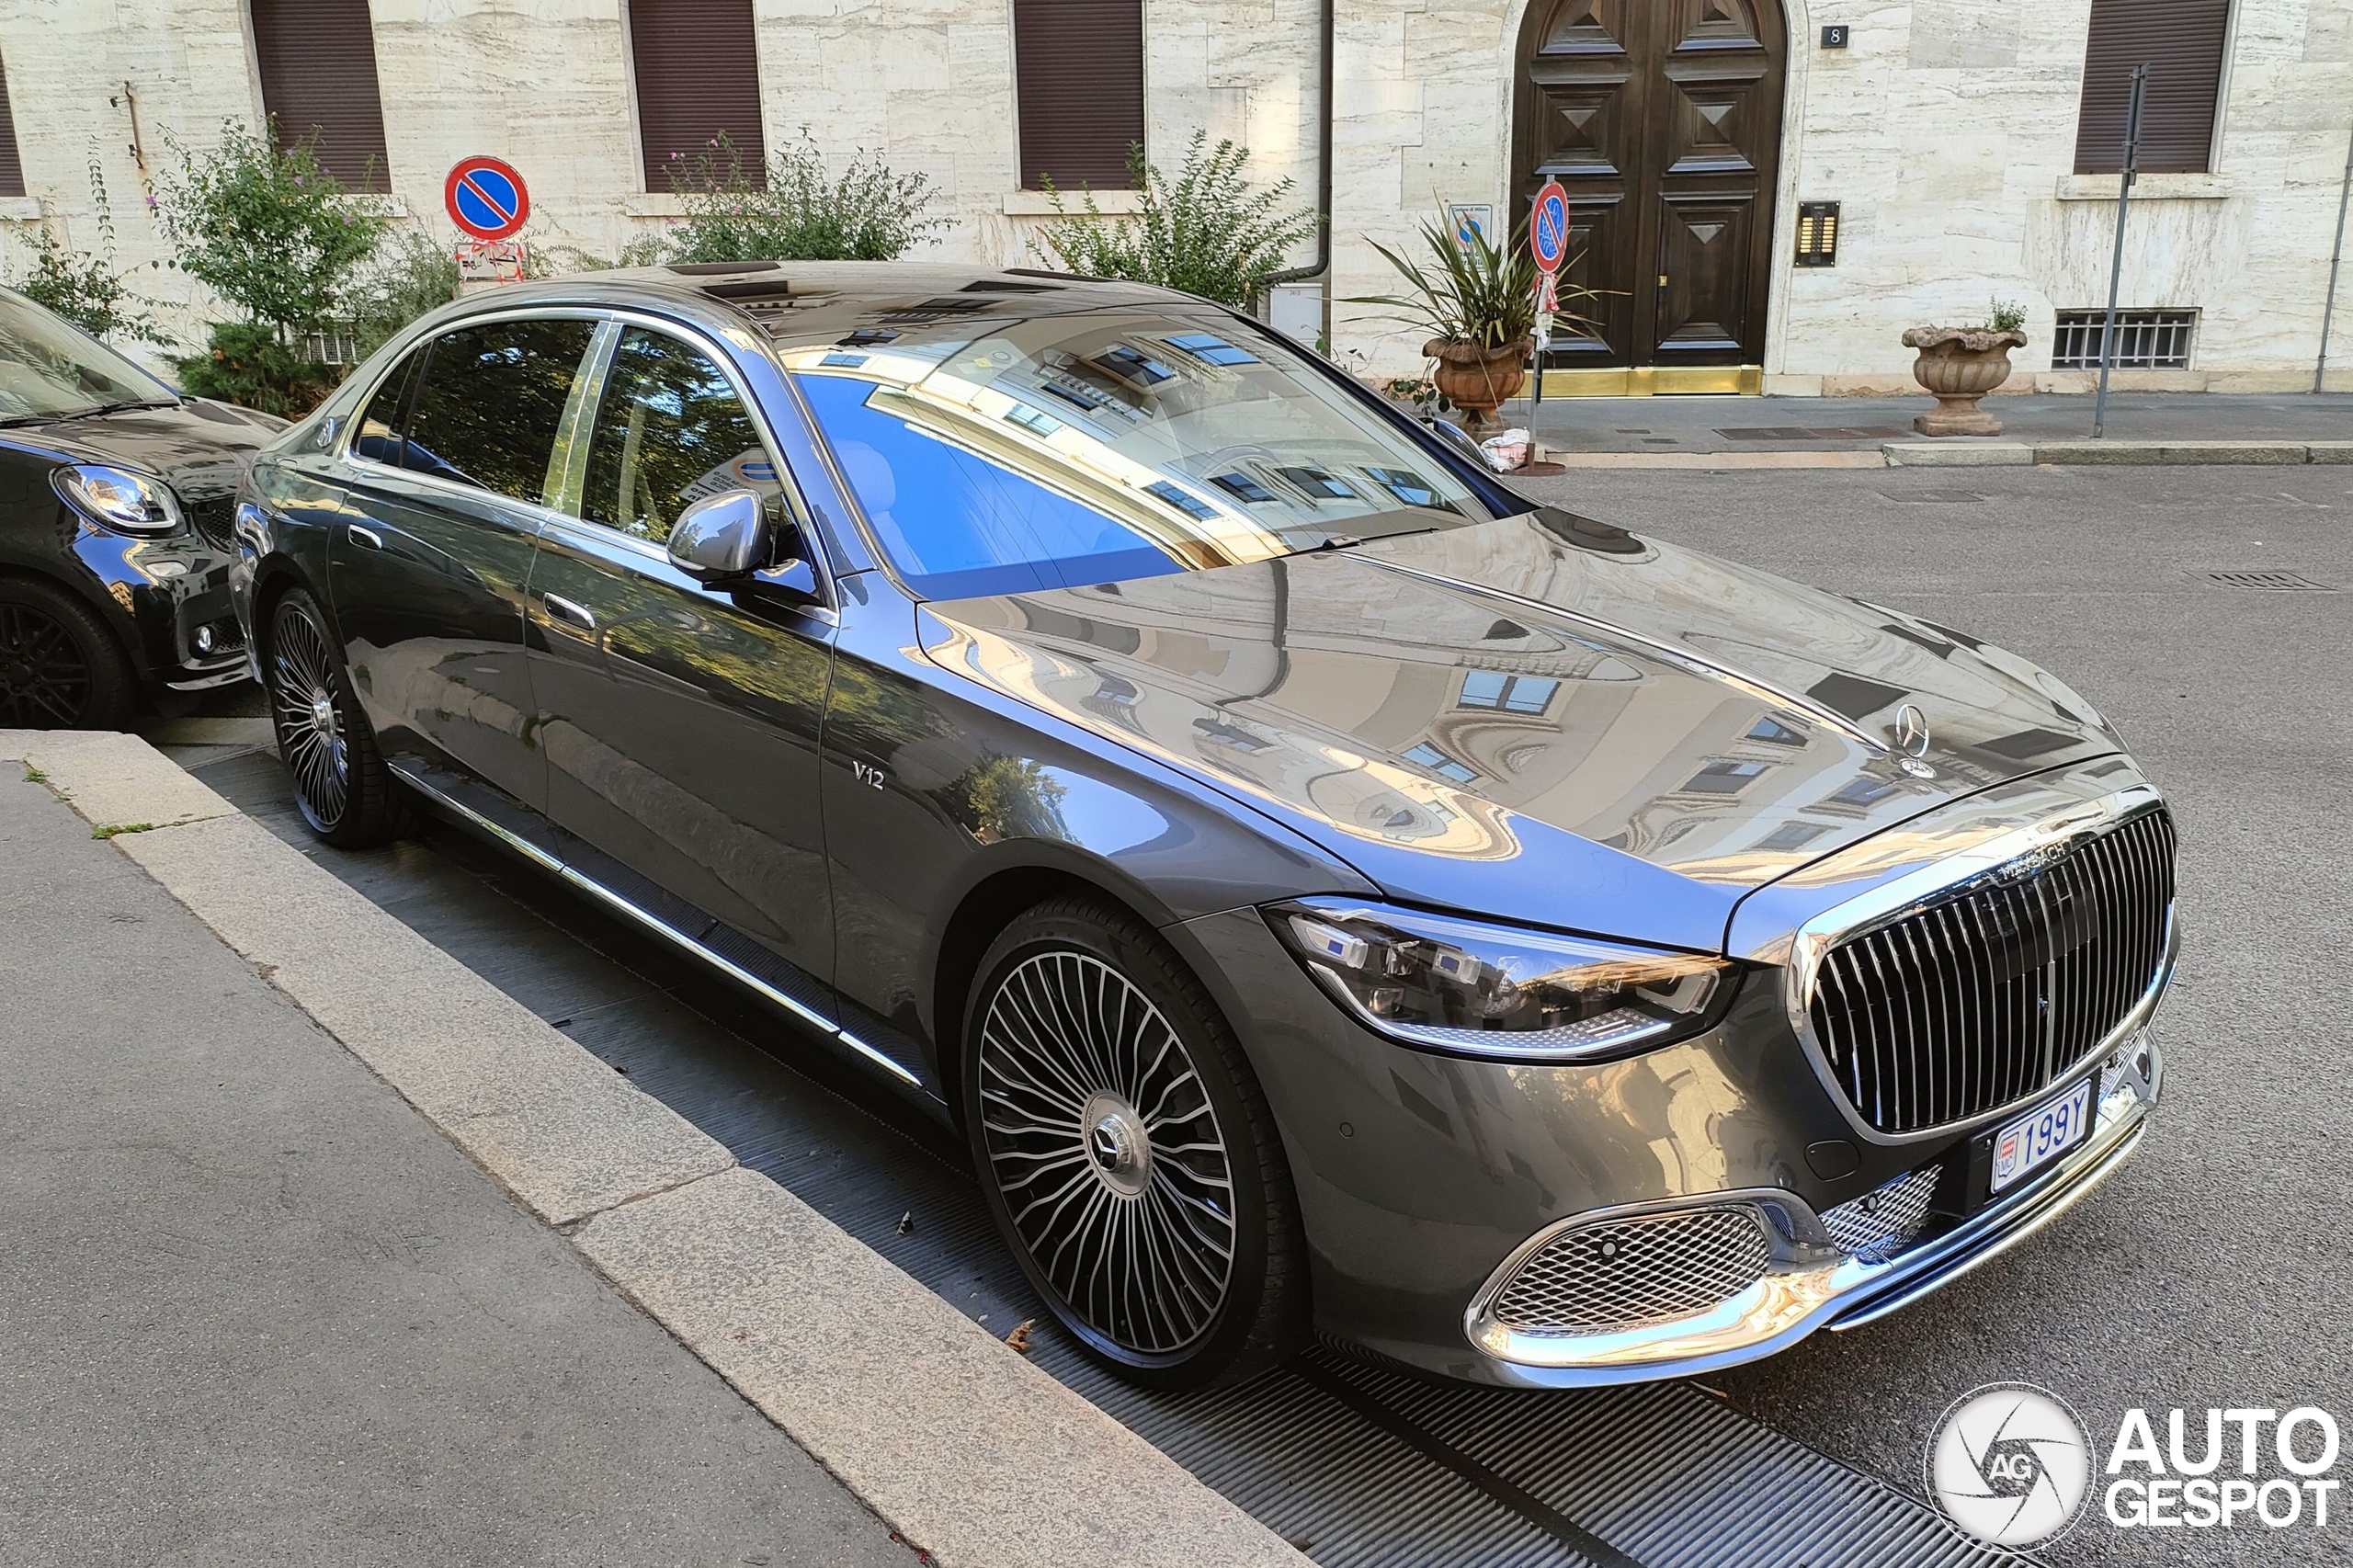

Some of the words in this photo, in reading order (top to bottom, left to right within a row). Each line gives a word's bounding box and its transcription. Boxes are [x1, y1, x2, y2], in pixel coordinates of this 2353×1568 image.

[1830, 28, 1840, 43] 8
[852, 760, 884, 790] V12
[2001, 1155, 2012, 1170] MC
[2026, 1091, 2086, 1165] 199Y
